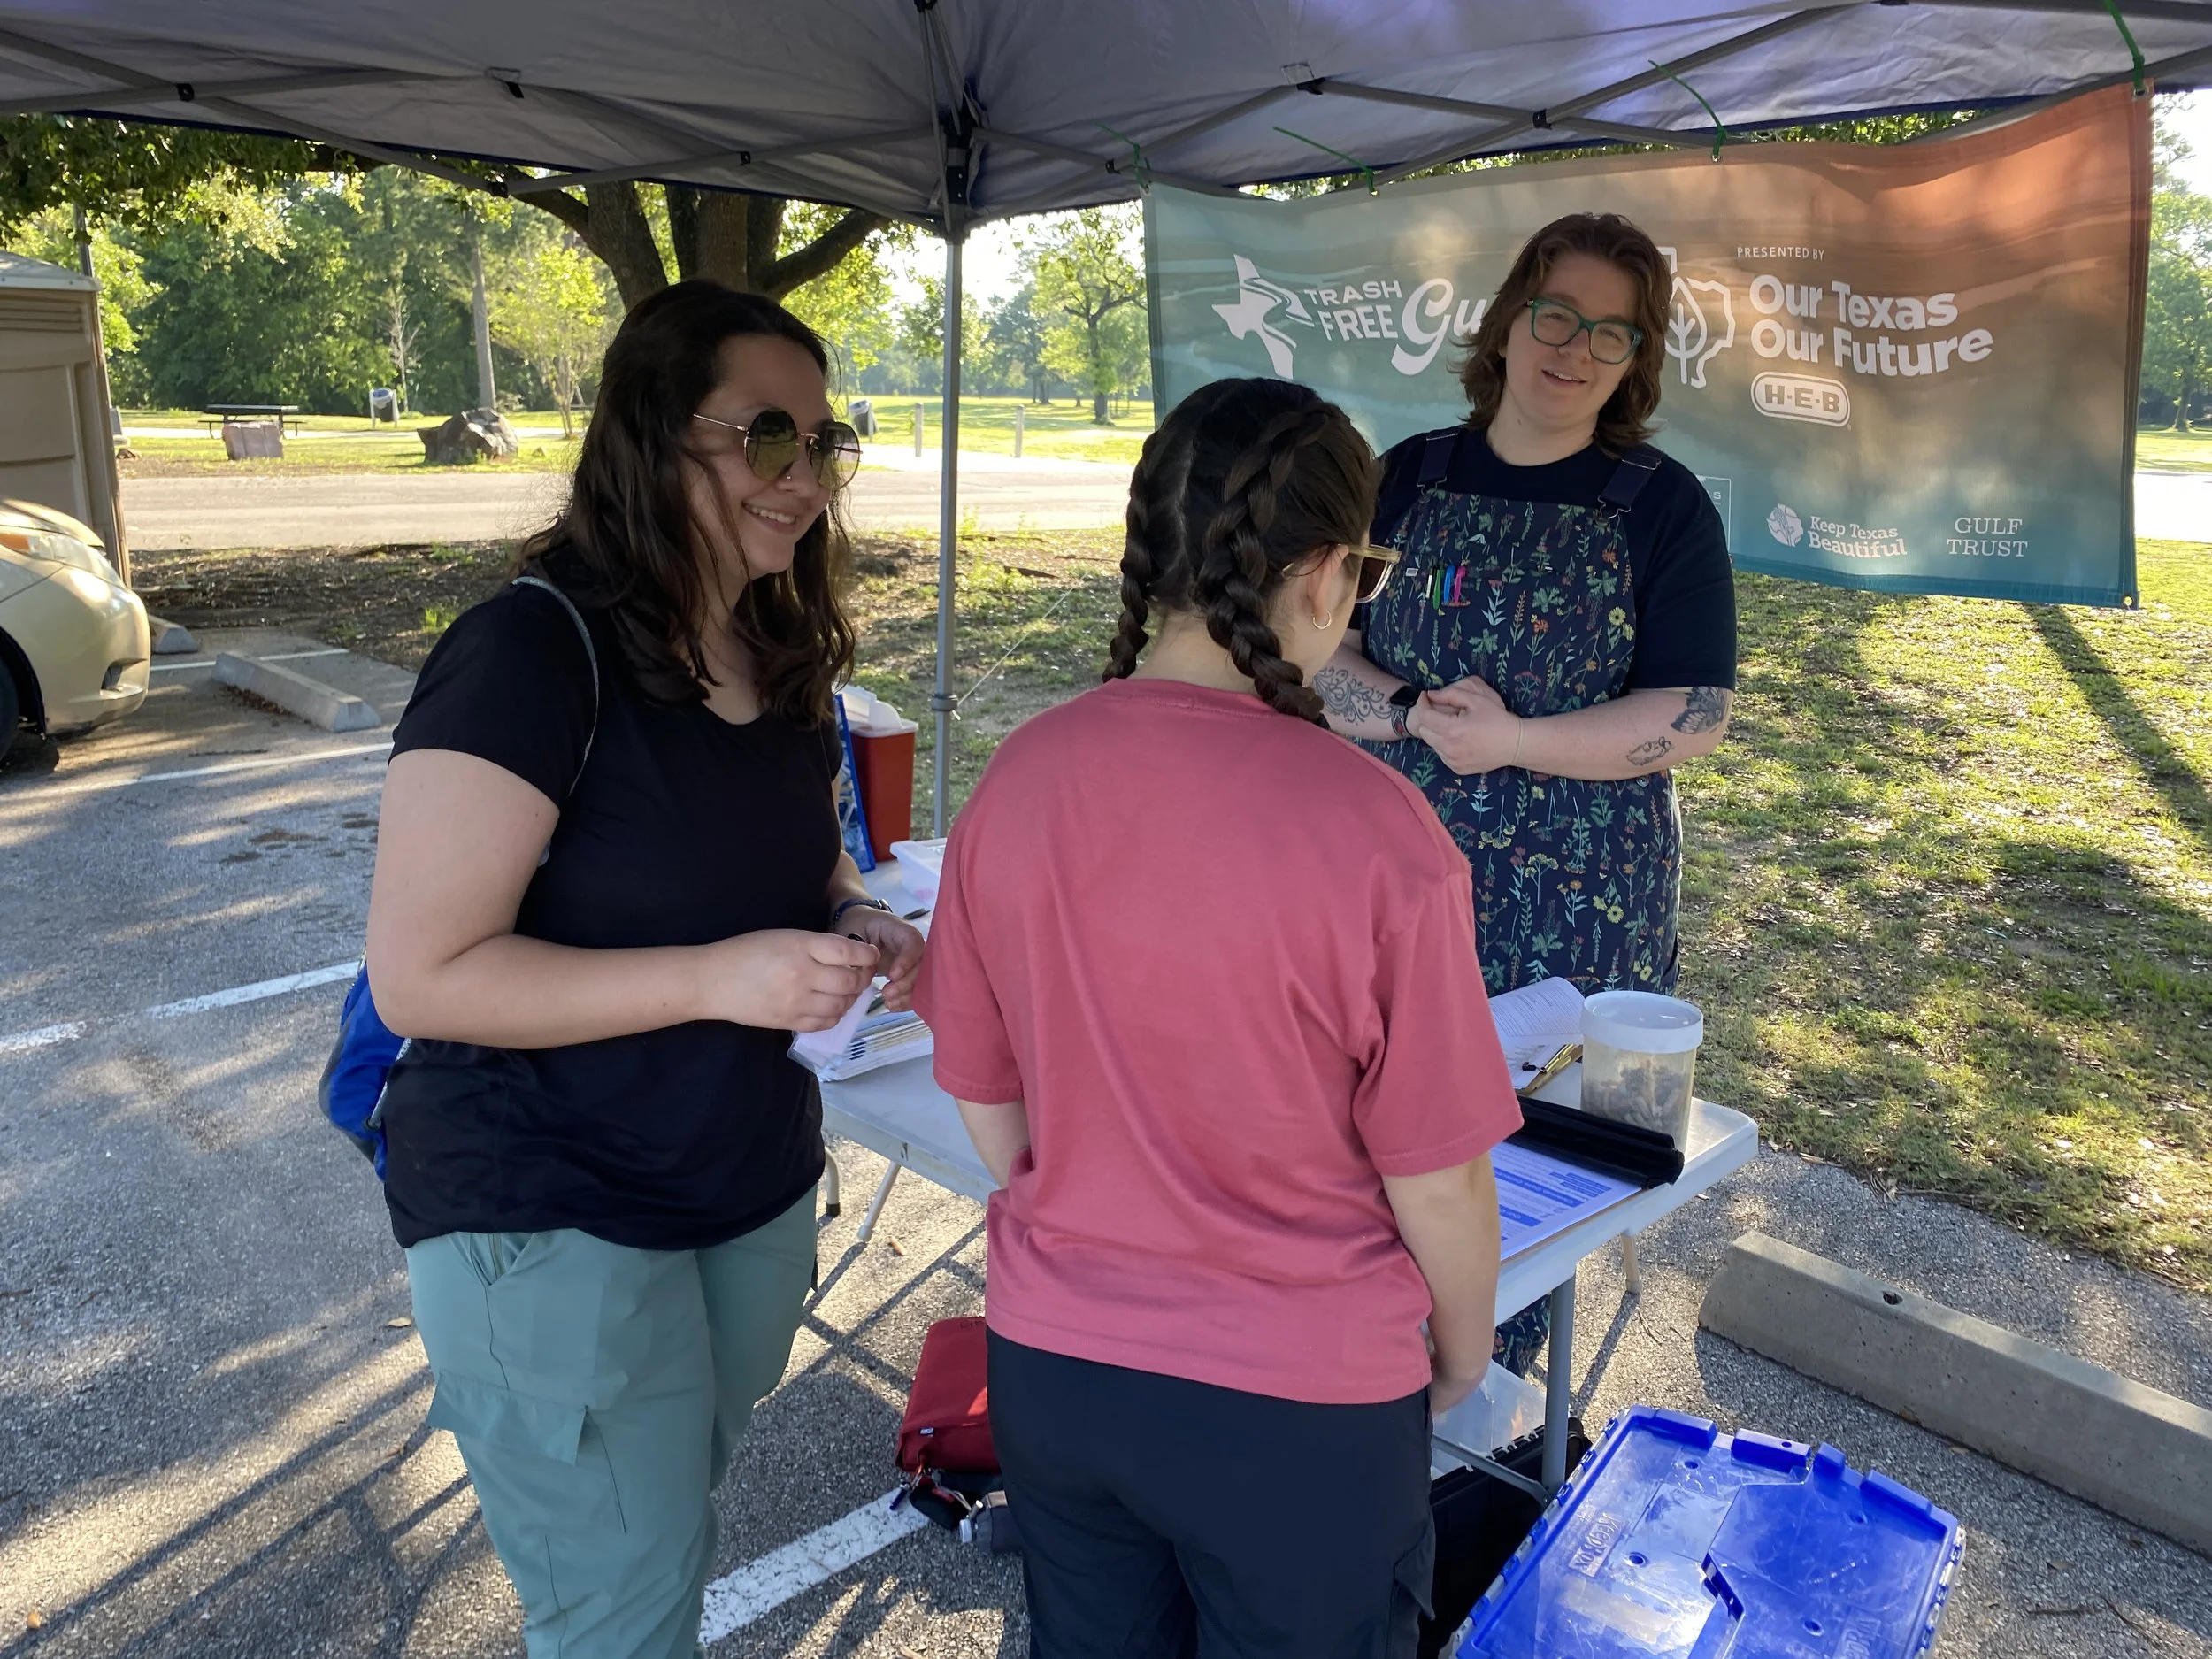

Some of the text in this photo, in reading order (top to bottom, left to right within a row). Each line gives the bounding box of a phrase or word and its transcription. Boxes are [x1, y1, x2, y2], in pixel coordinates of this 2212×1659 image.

[1737, 247, 1824, 262] PRESENTED BY
[1304, 280, 1402, 306] TRASH
[1749, 274, 1958, 331] Our Texas
[1317, 278, 1487, 375] FREE Gu
[1750, 319, 1993, 377] Our Future
[1809, 516, 1898, 540] Keep Texas
[1954, 517, 2024, 535] GULF
[1807, 529, 1908, 559] Beautiful
[1947, 538, 2028, 558] TRUST
